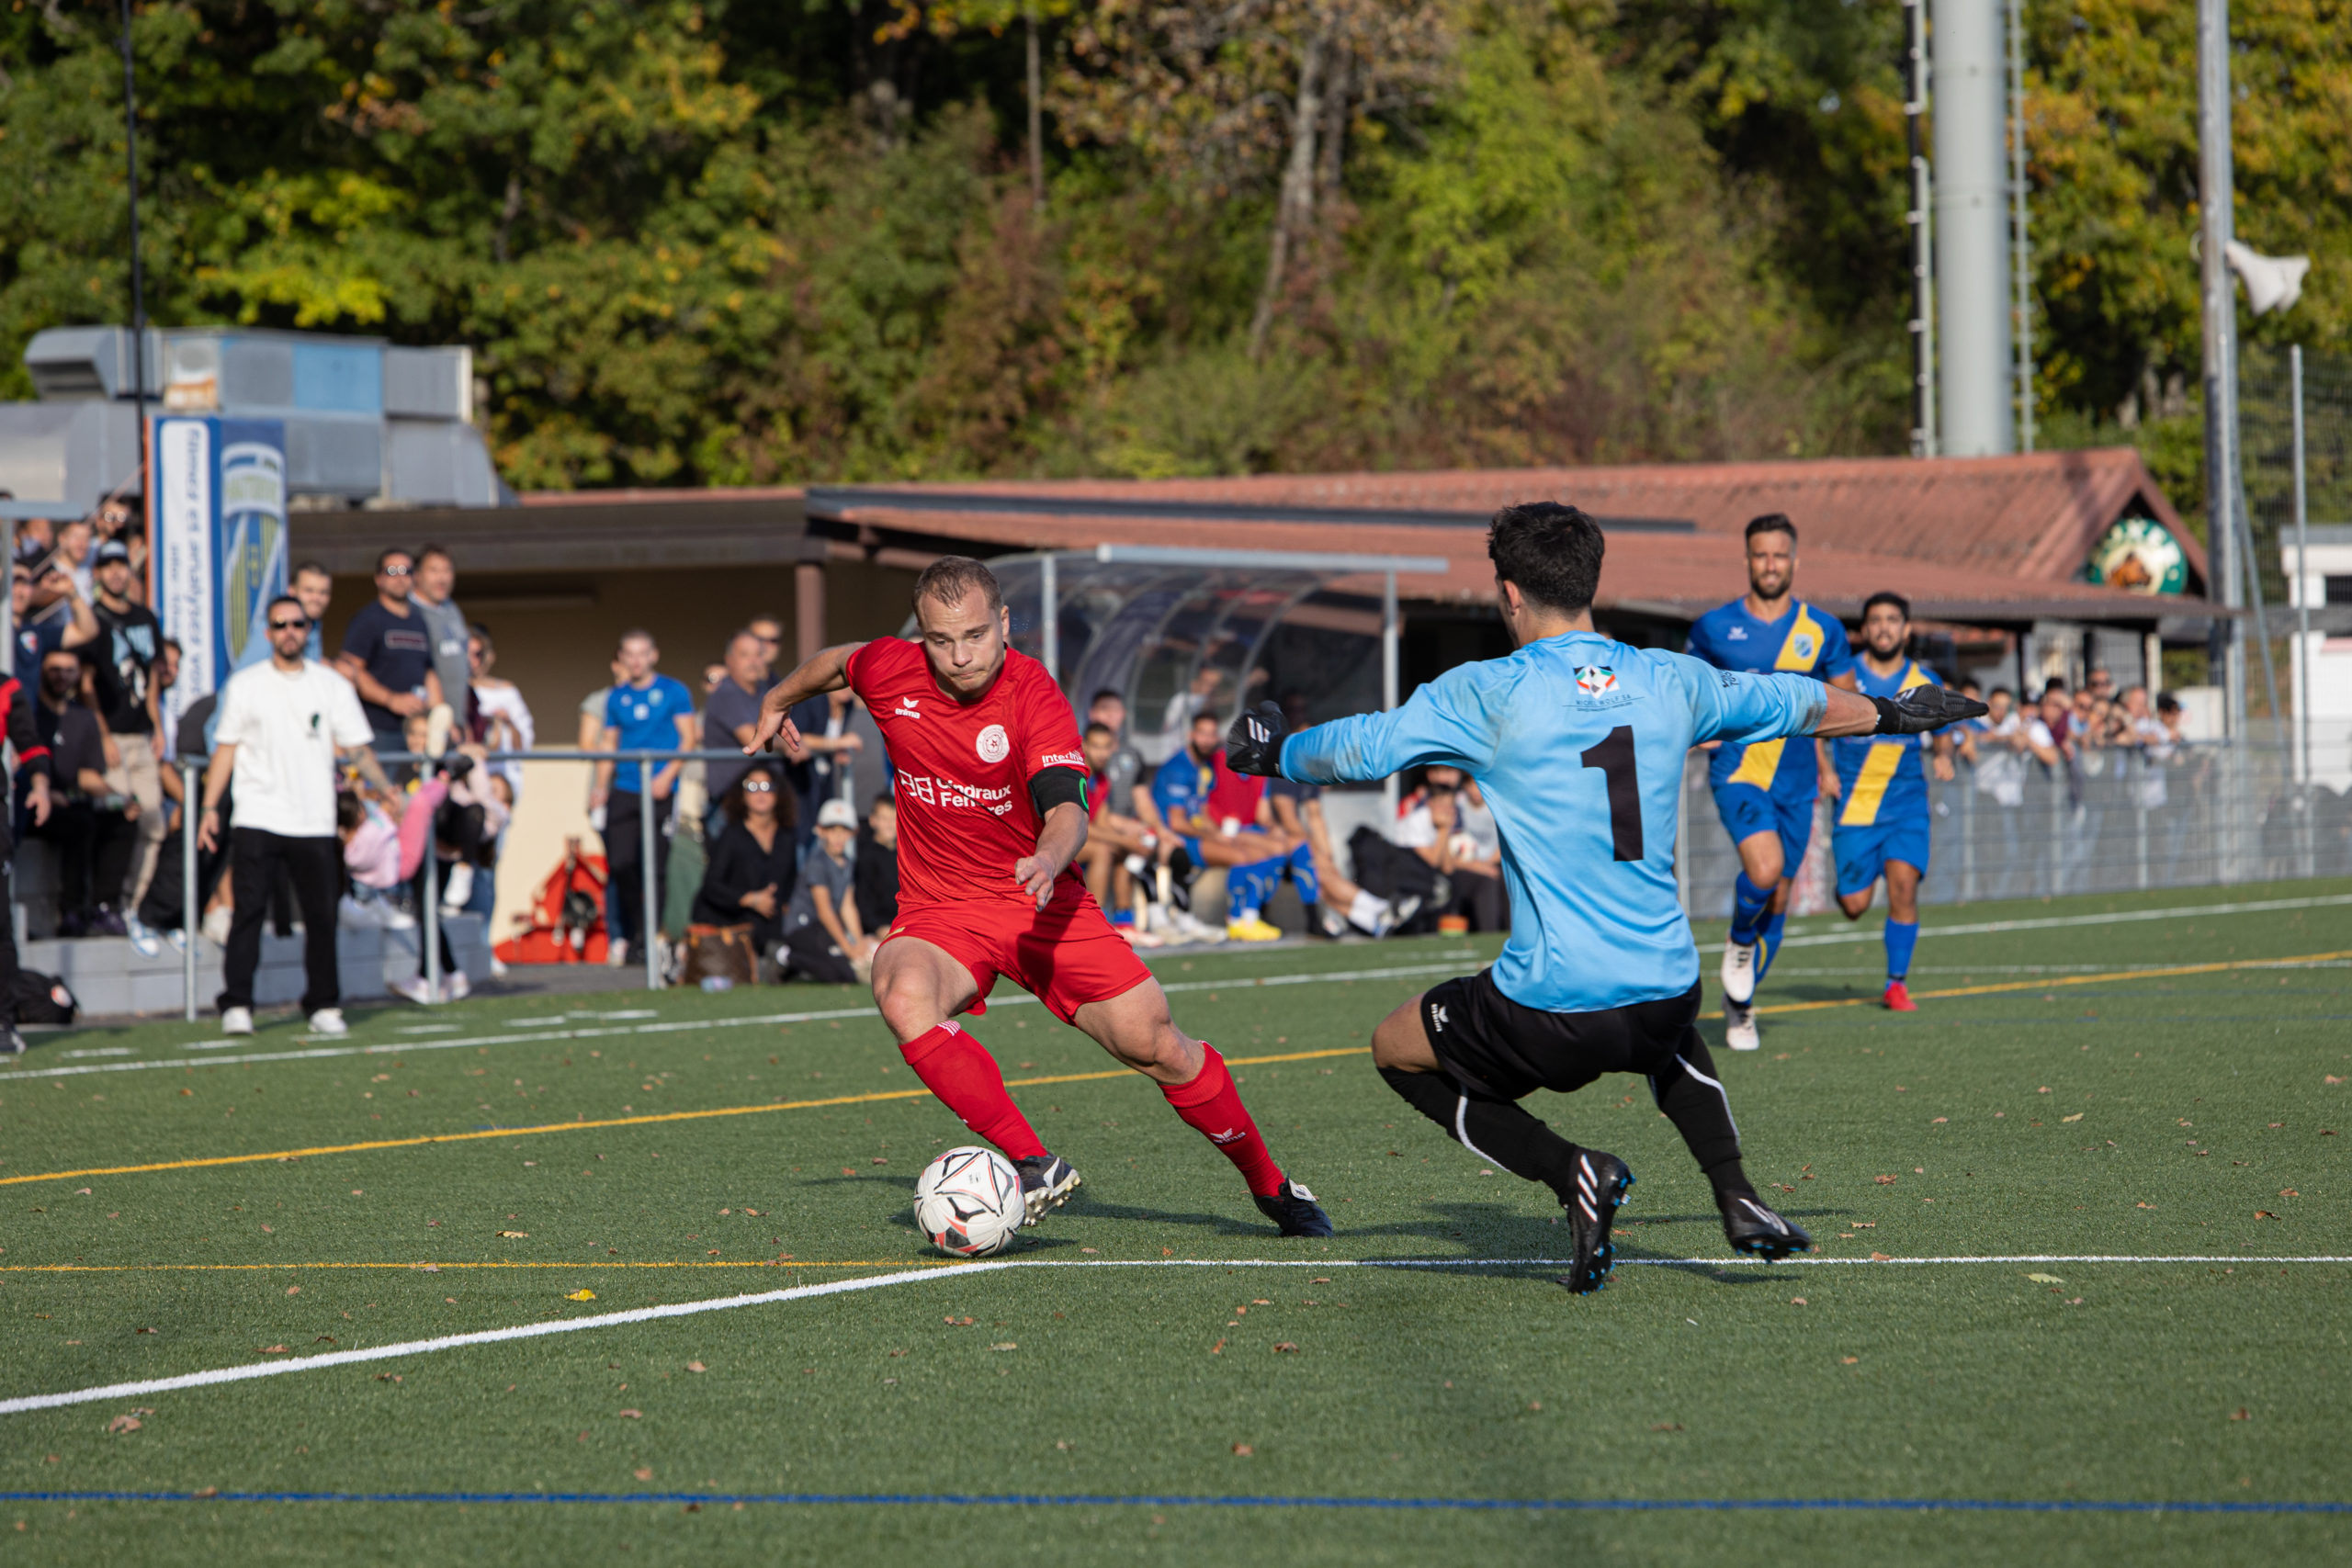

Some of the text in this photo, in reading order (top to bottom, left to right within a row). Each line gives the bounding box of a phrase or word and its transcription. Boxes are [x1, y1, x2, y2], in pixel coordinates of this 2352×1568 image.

[895, 707, 921, 719] erima
[936, 778, 1012, 800] ndraux
[1580, 725, 1644, 862] 1
[940, 792, 1013, 816] Fenres
